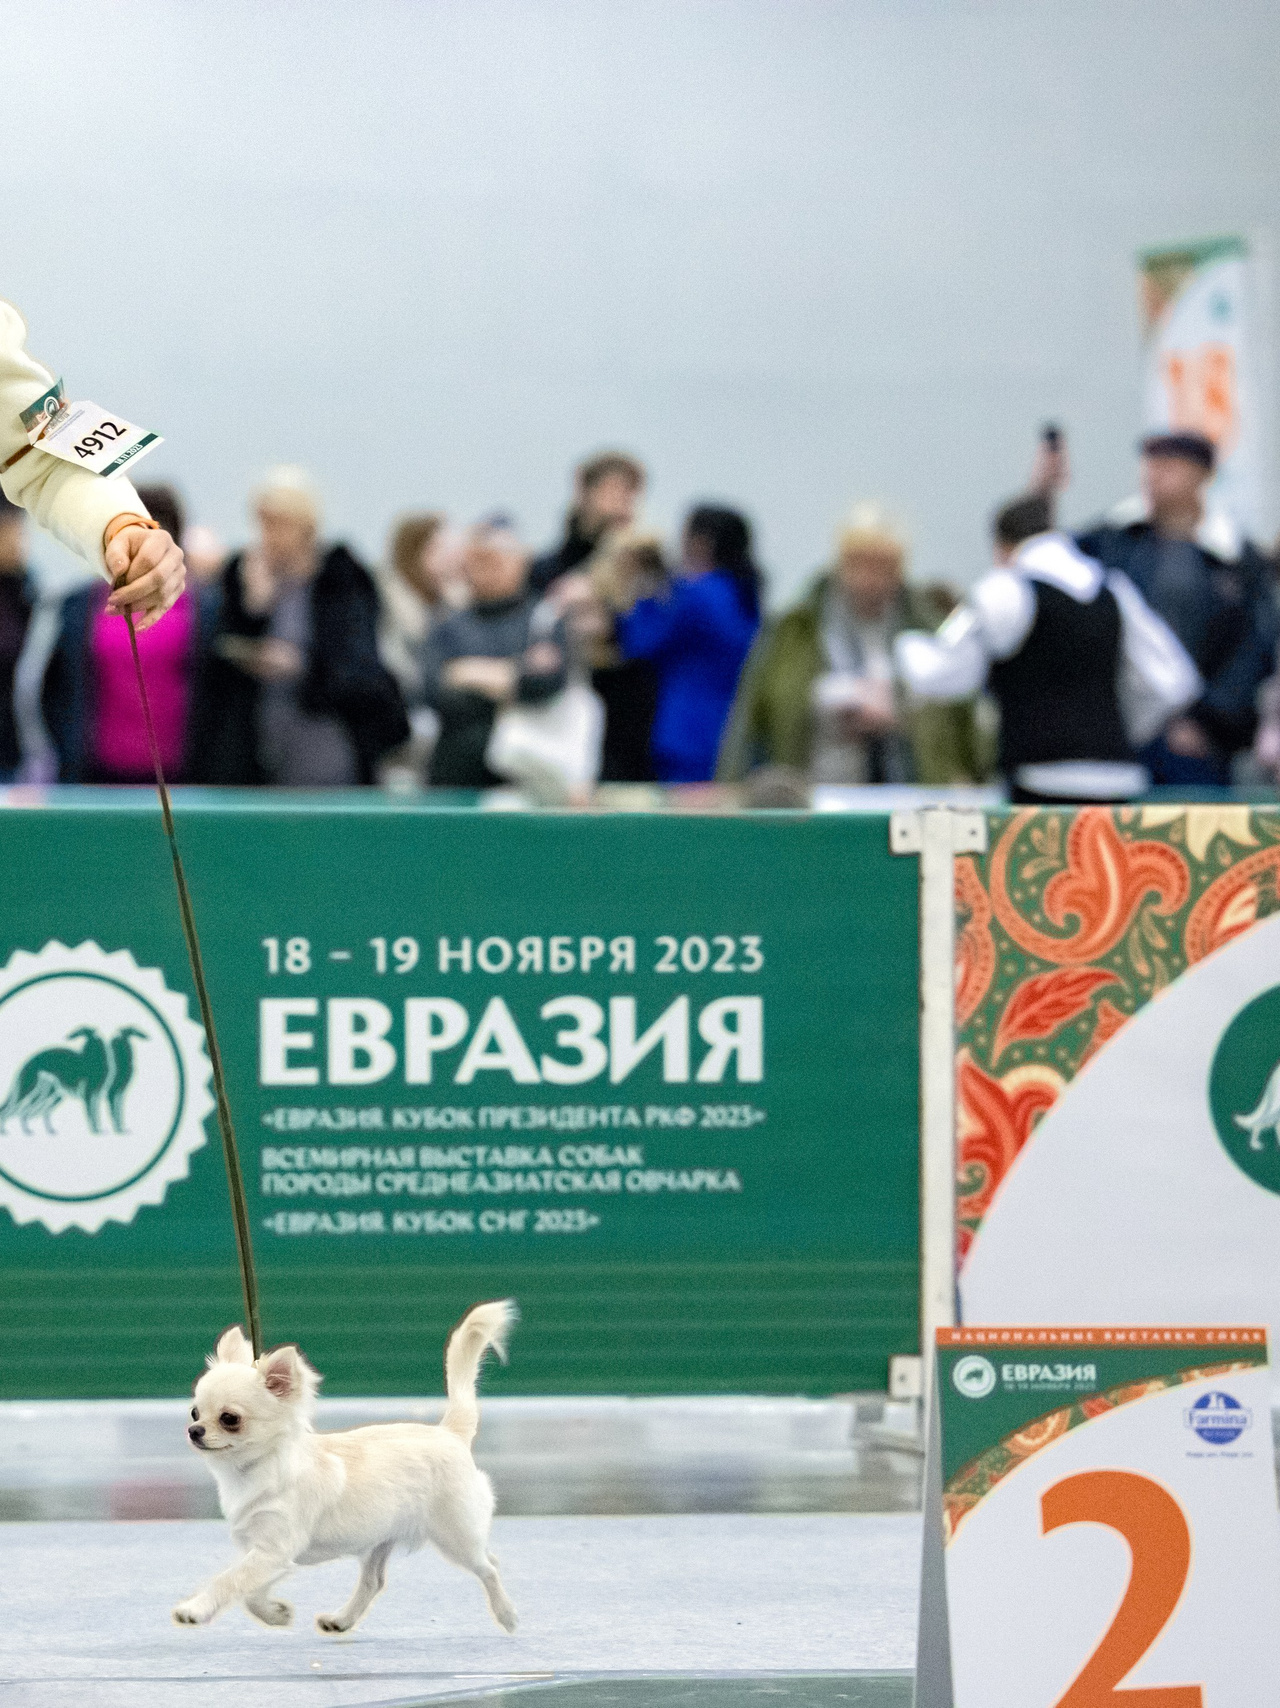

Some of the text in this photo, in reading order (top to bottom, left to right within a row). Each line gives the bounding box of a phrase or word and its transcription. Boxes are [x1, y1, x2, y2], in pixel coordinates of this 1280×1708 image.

[73, 421, 127, 459] 4912
[261, 936, 312, 975] 18
[369, 936, 420, 975] 19
[438, 935, 636, 974] НОЯБРЯ
[654, 934, 765, 974] 2023
[259, 995, 764, 1086] ЕВРАЗИЯ
[392, 1106, 475, 1130] КУБОК
[478, 1105, 641, 1131] ПРЕЗИДЕНТА
[419, 1146, 554, 1169] ВЫСТАВКА
[557, 1144, 644, 1168] СОБАК
[392, 1210, 475, 1234] КУБОК
[1001, 1363, 1097, 1382] ЕВРАЗИЯ
[1040, 1470, 1207, 1708] 2
